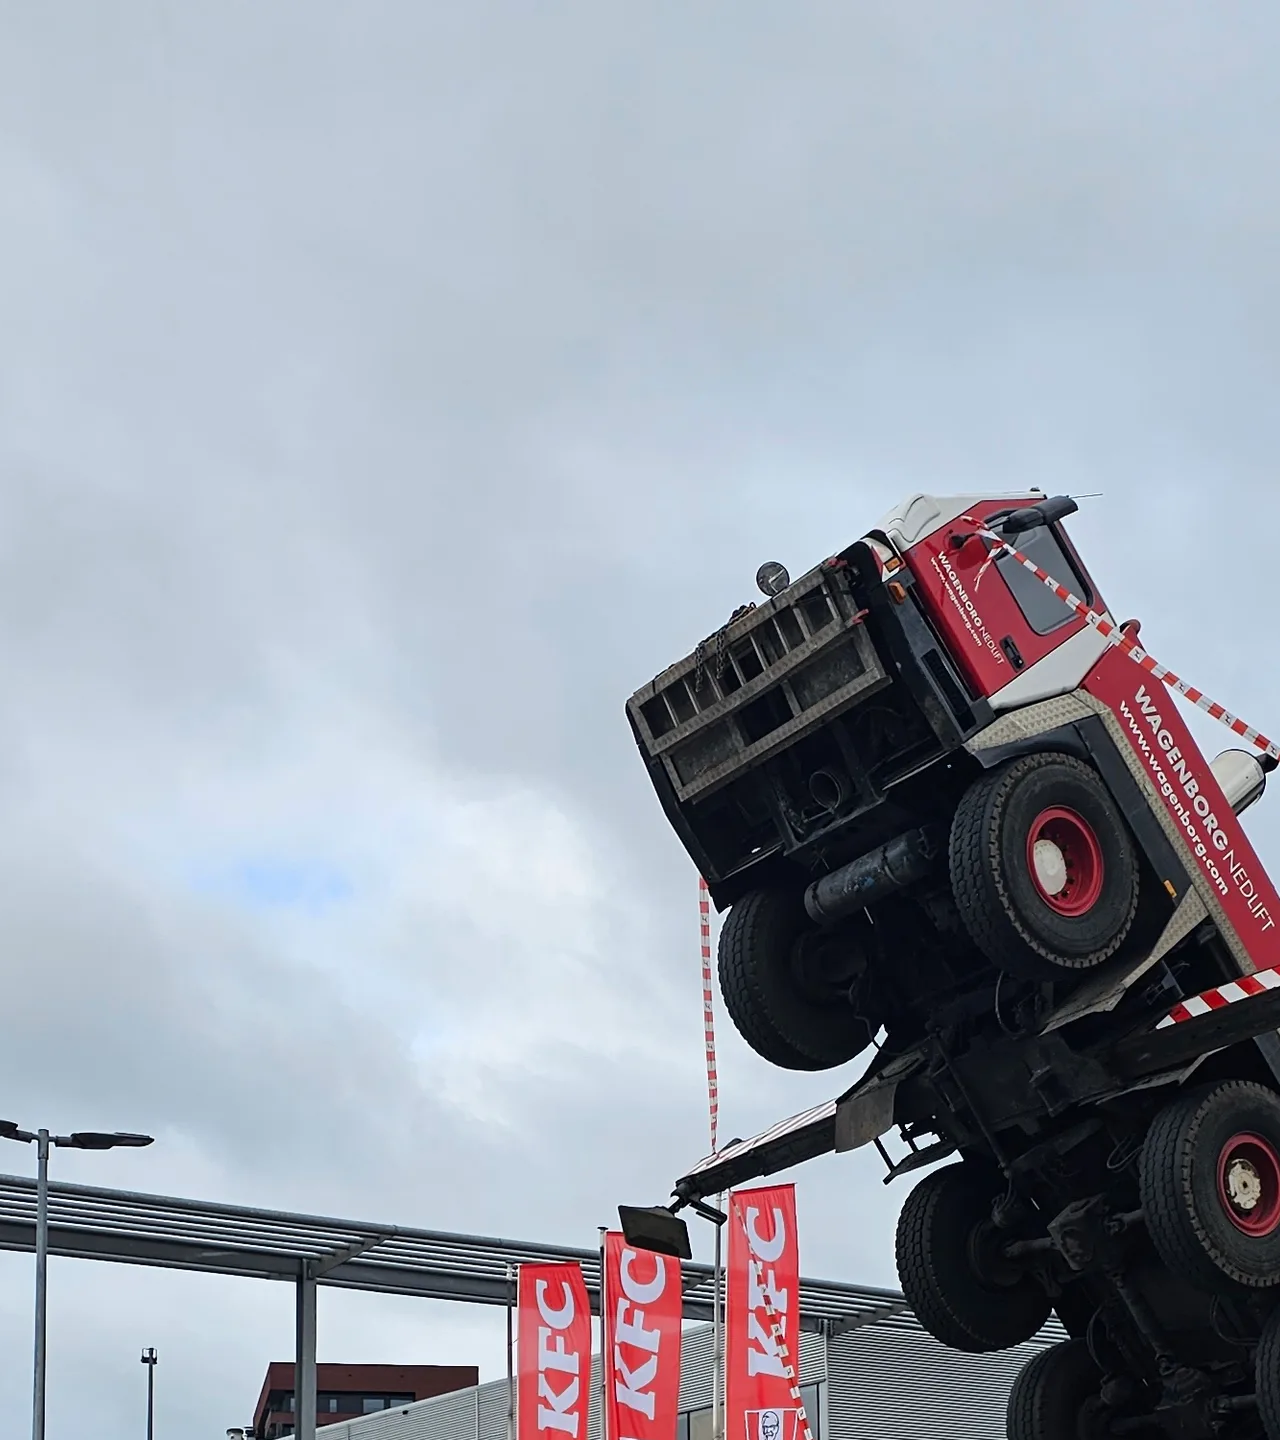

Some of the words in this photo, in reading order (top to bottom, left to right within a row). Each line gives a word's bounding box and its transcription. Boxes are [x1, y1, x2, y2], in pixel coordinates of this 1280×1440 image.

[930, 556, 982, 647] www.wagenborg.com
[938, 551, 983, 628] WAGENBORG
[978, 626, 1005, 665] NEDLIFT
[1119, 700, 1230, 896] www.wagenborg.com
[1134, 684, 1229, 852] WAGENBORG
[1222, 849, 1276, 932] NEDLIFT
[535, 1278, 580, 1440] KFC
[614, 1247, 666, 1421] KFC
[745, 1206, 788, 1377] KFC
